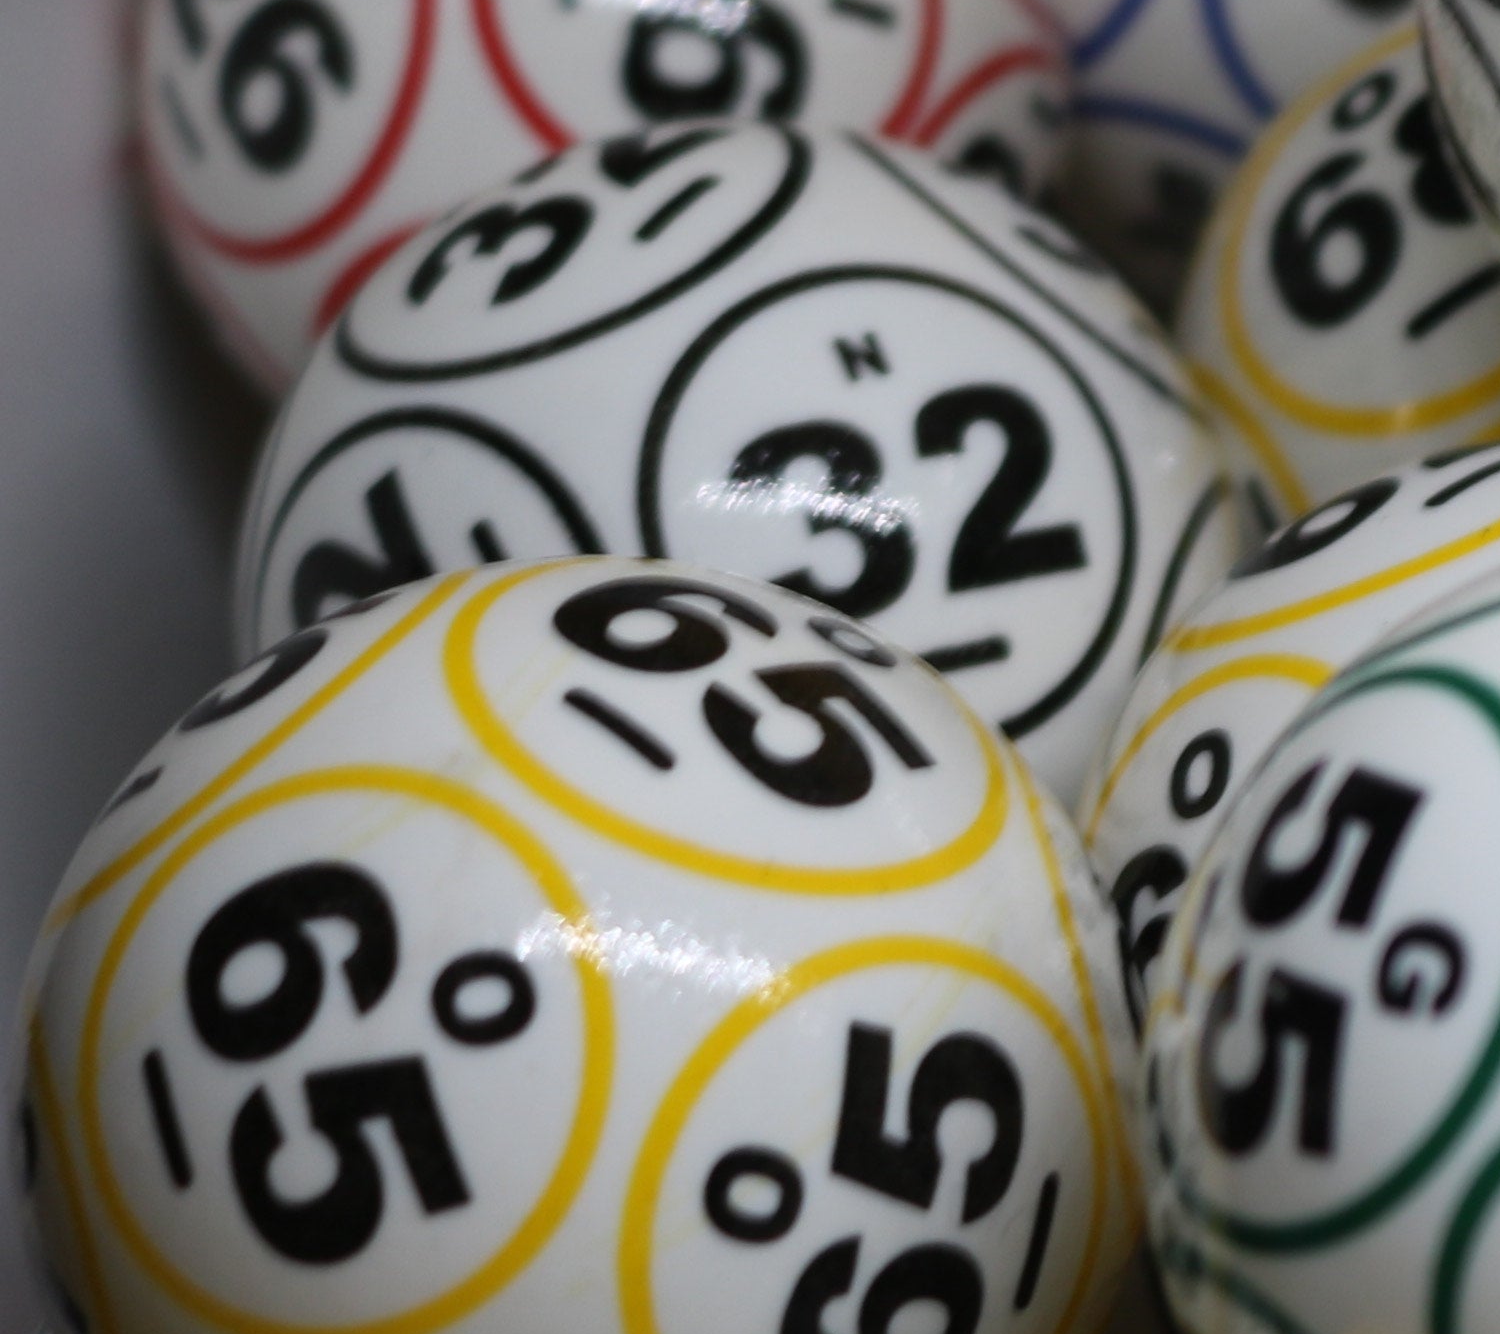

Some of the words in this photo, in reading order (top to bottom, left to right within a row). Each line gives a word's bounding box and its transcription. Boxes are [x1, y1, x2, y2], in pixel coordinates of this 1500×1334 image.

[1328, 73, 1398, 134] O
[831, 332, 891, 382] N
[723, 384, 1089, 617] 32
[553, 574, 939, 808] 65
[432, 949, 538, 1046] O
[1201, 754, 1428, 1158] 55
[1376, 919, 1468, 1021] G
[185, 859, 473, 1266] 65
[702, 1143, 804, 1246] O
